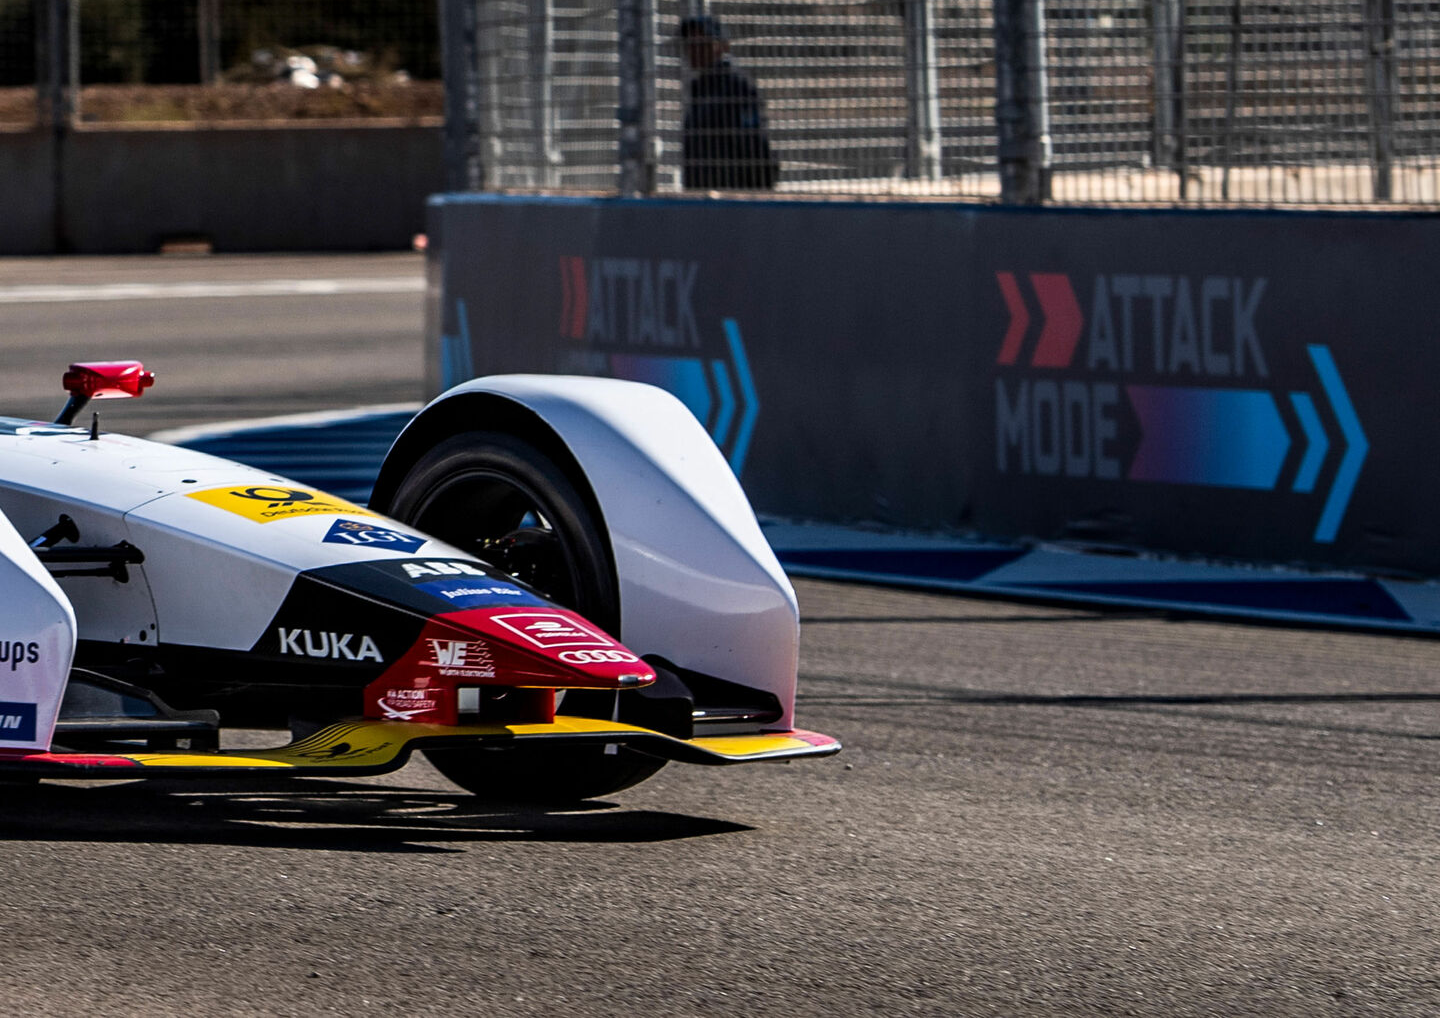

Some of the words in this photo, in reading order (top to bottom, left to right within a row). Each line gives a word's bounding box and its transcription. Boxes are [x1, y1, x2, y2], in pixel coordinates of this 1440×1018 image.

[588, 257, 701, 349] ATTACK
[1087, 273, 1268, 377] ATTACK
[995, 379, 1120, 479] MODE
[334, 530, 416, 546] LGT
[401, 561, 487, 579] ABB
[277, 627, 384, 663] KUKA
[397, 689, 426, 700] ACTION
